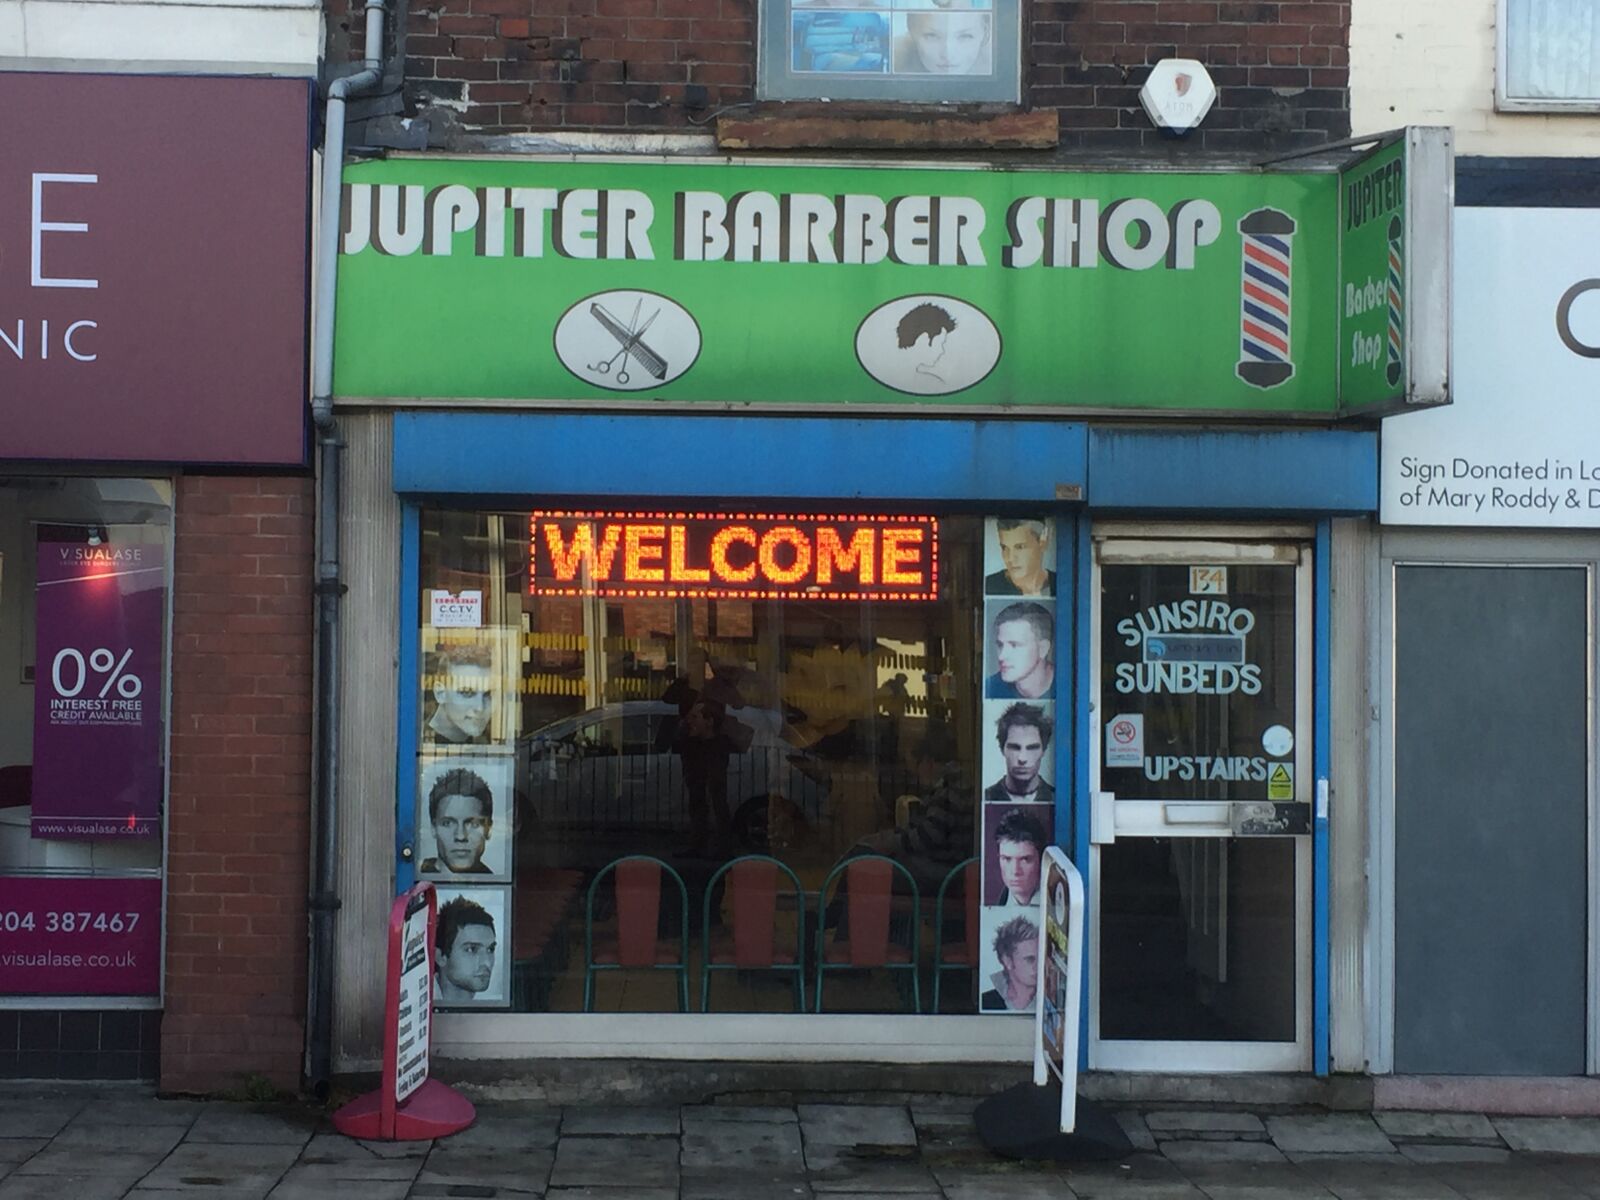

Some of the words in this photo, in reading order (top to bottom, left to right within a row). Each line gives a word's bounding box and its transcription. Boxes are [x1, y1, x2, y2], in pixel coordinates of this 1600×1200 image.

[1347, 157, 1402, 232] JUPITER
[31, 173, 98, 288] E
[341, 184, 655, 259] JUPITER
[675, 190, 987, 266] BARBER
[1002, 196, 1221, 270] SHOP
[1345, 275, 1388, 318] Barber
[0, 319, 97, 361] NIC
[1351, 330, 1382, 370] Shop
[1400, 457, 1446, 483] Sign
[1453, 458, 1548, 480] Donated
[1556, 459, 1572, 480] in
[1400, 484, 1422, 506] of
[1428, 487, 1486, 513] Mary
[1492, 485, 1560, 514] Roddy
[1565, 488, 1581, 508] &
[60, 548, 142, 561] VSUALASE
[543, 522, 923, 585] WELCOME
[1192, 567, 1225, 592] 134
[440, 604, 472, 613] CCTV
[1117, 600, 1255, 646] SUNSIRO
[52, 647, 142, 698] 0%
[1116, 663, 1262, 695] SUNBEDS
[50, 710, 86, 720] CREDIT
[89, 711, 142, 721] AVAILABLE
[51, 699, 109, 710] INTEREST
[112, 700, 142, 710] FREE
[1143, 756, 1267, 781] UPSTAIRS
[38, 823, 150, 834] www.visualase.co.uk
[0, 911, 36, 931] 04
[46, 912, 140, 932] 387467
